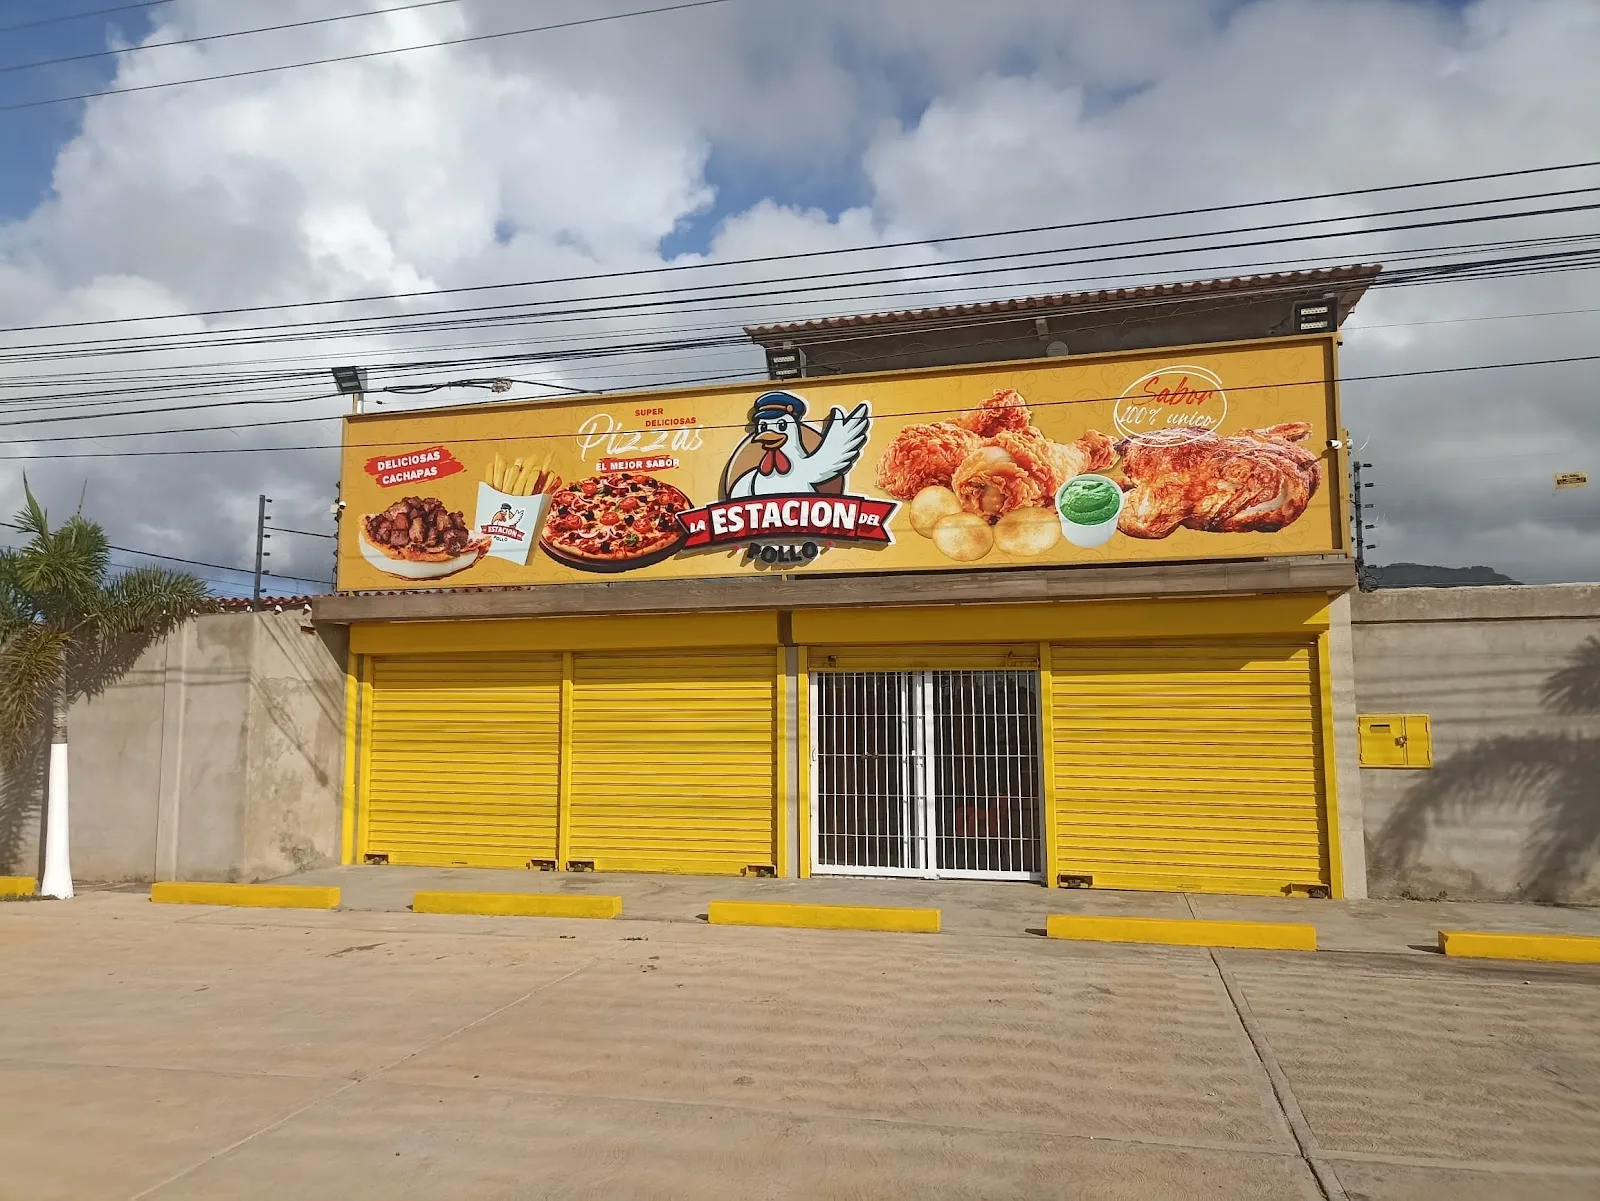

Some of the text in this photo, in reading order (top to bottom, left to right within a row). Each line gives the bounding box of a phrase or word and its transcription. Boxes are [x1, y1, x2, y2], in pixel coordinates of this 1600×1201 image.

[1132, 376, 1213, 406] Sabor
[635, 408, 664, 416] SUPER
[645, 417, 697, 427] DELICIOSAS
[1119, 405, 1162, 425] 100%
[576, 413, 704, 462] Pizzas
[377, 451, 441, 471] DELICIOSAS
[596, 458, 680, 471] EL MEJOR SABOR
[382, 466, 438, 484] CACHAPAS
[689, 500, 880, 535] LA ESTACION DEL
[487, 526, 518, 538] ESTACION
[747, 541, 819, 564] POLLO
